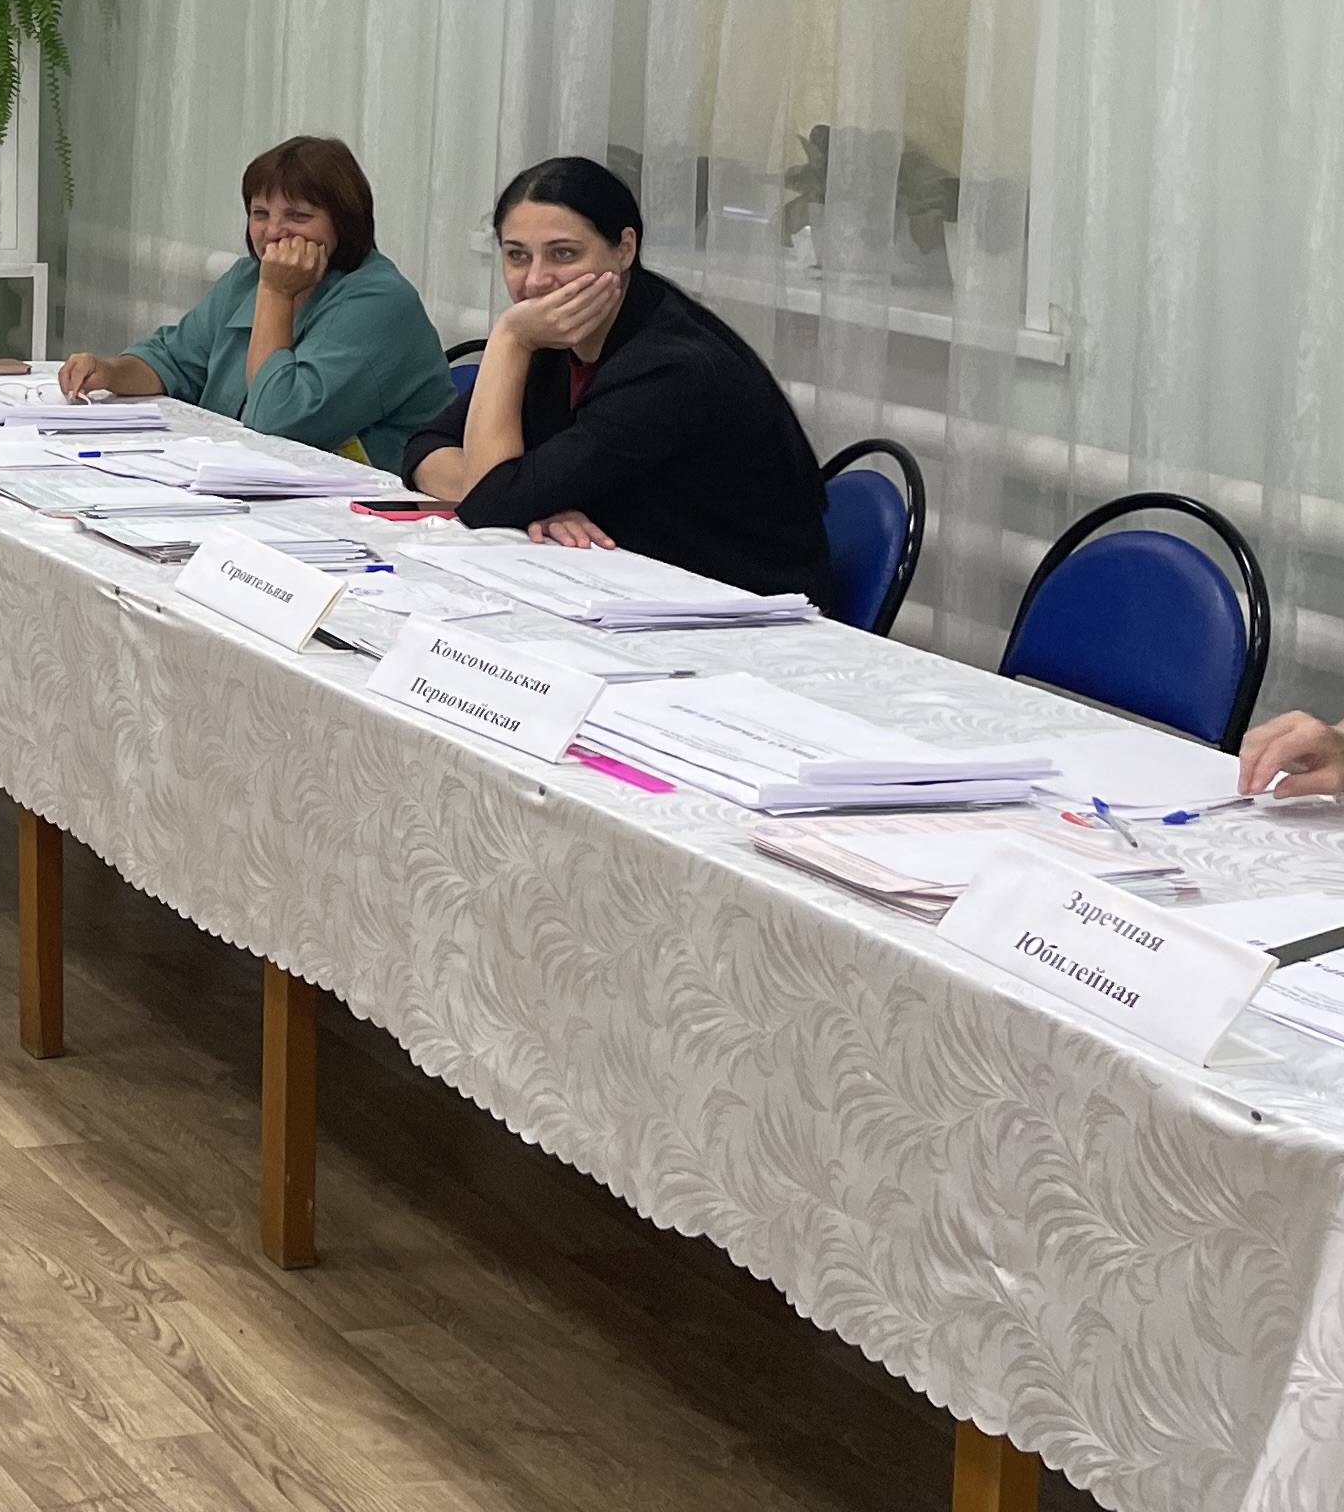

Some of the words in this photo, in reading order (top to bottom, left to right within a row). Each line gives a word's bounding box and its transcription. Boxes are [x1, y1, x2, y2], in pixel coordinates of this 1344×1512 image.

[220, 559, 293, 604] Строительная
[430, 637, 551, 696] Комсомольская
[410, 676, 521, 733] Первомайская
[1063, 889, 1166, 953] Заречная
[1013, 930, 1141, 1009] Юбилейная
